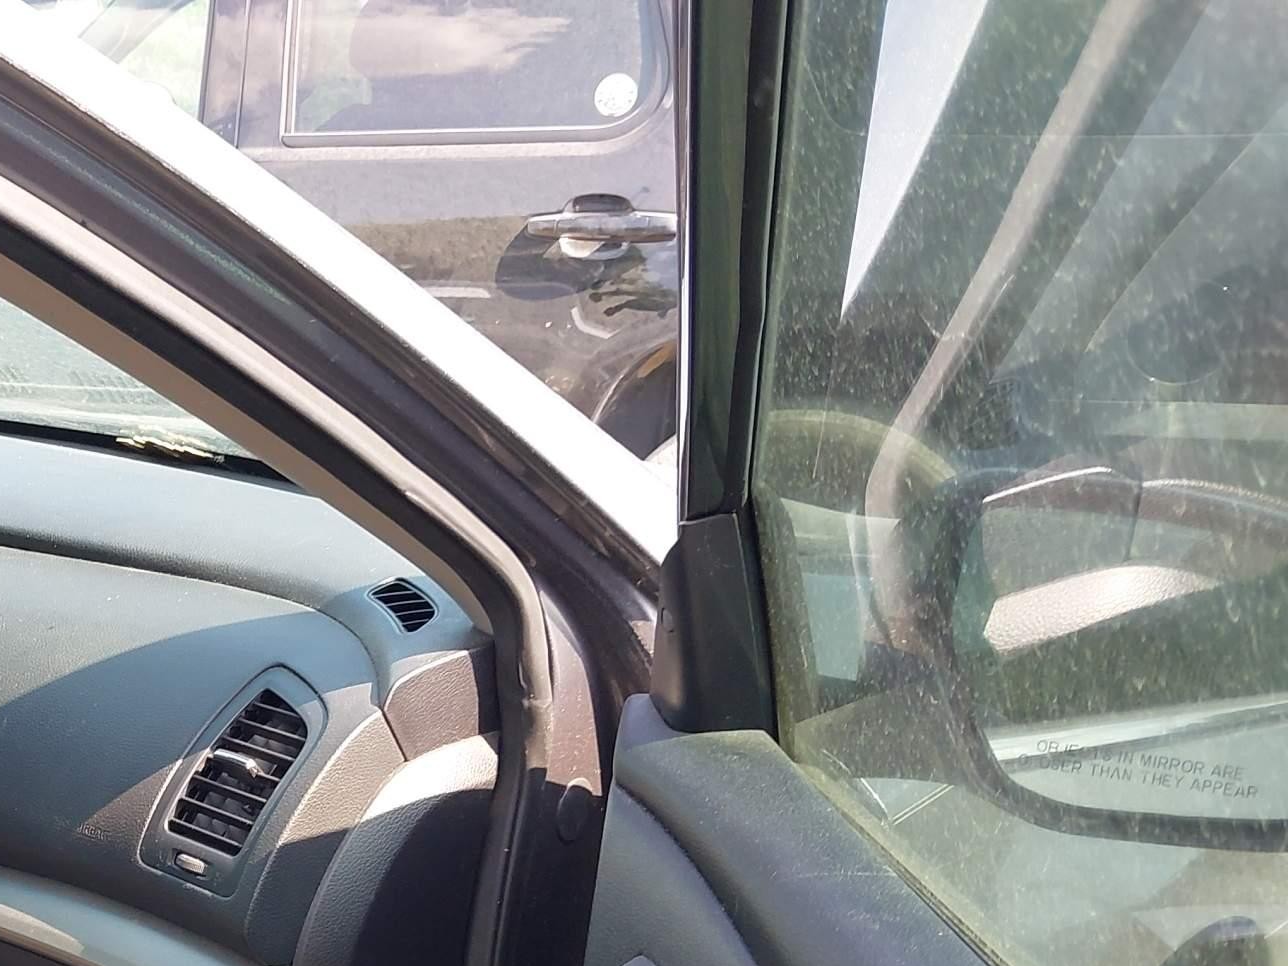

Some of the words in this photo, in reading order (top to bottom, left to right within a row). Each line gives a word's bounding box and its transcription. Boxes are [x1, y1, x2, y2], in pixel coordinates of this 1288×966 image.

[1037, 739, 1111, 762] OBJETS
[1118, 751, 1135, 765] IN
[1140, 753, 1205, 775] MIRROR
[1211, 764, 1246, 781] ARE
[1092, 762, 1133, 781] THAN
[1141, 770, 1185, 789] THEY
[1190, 778, 1259, 798] APPEAR
